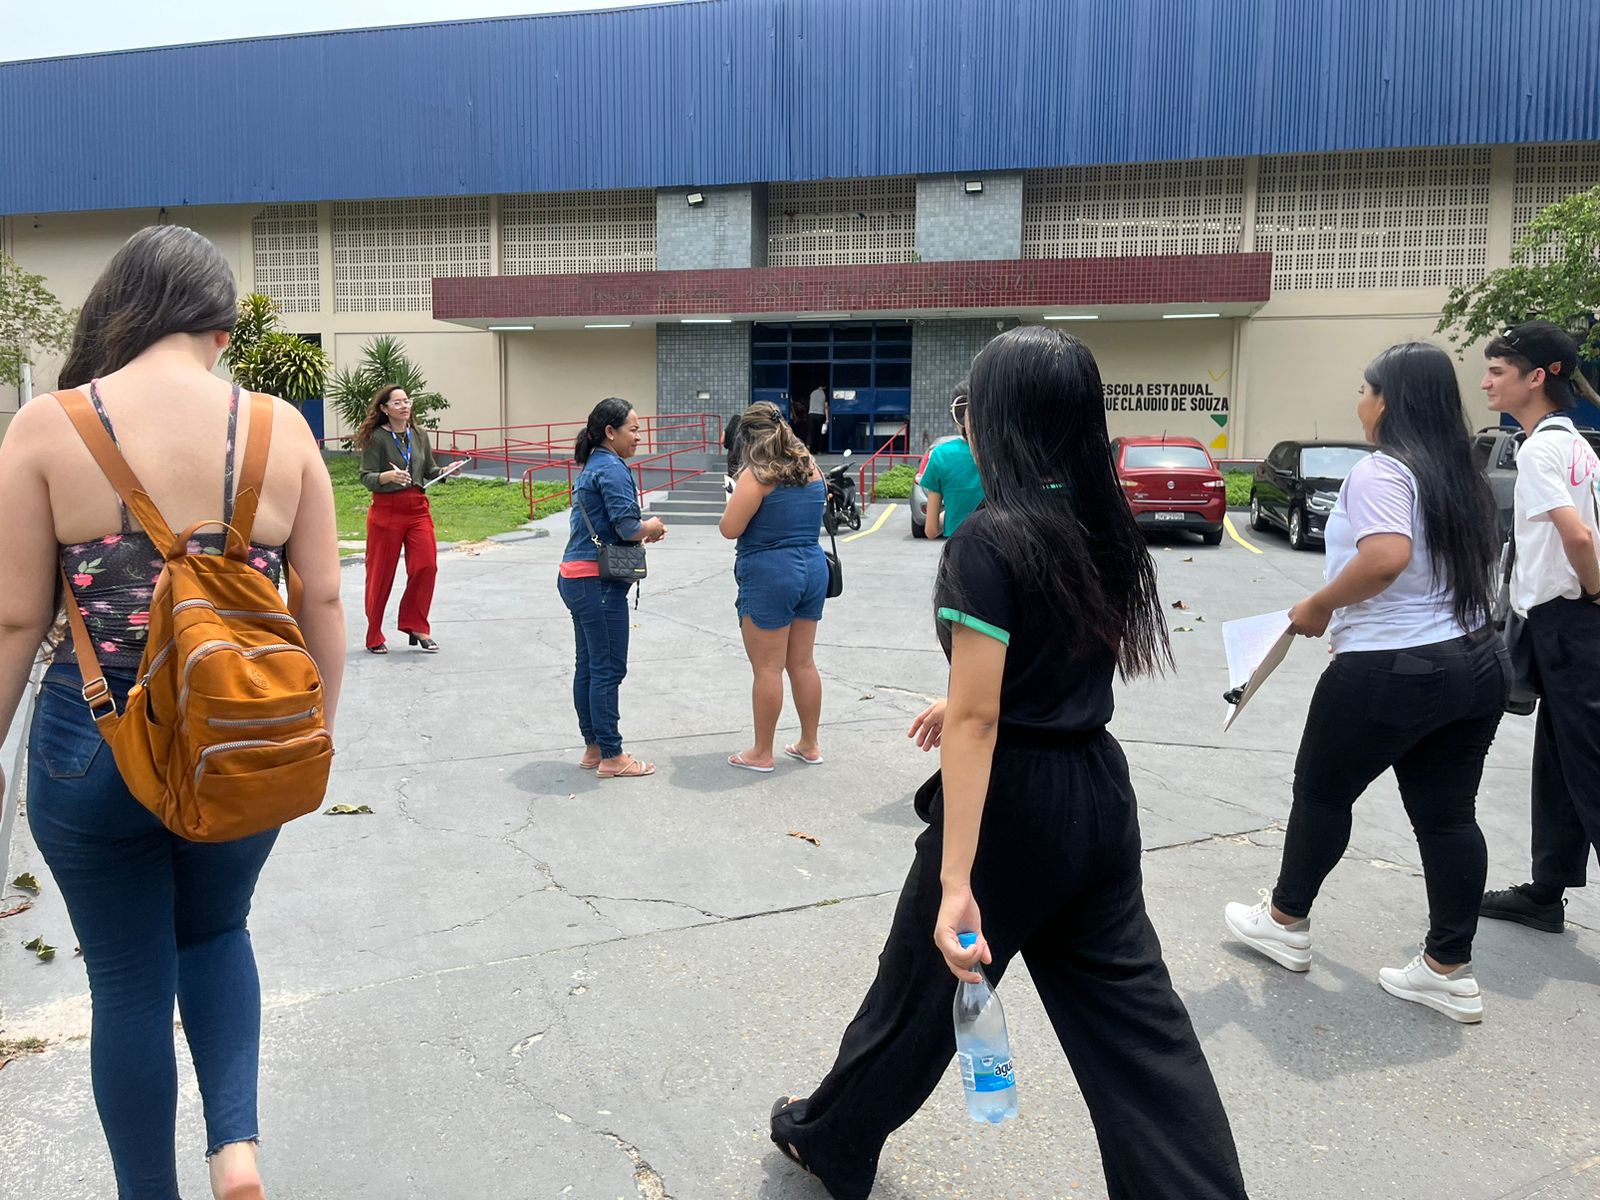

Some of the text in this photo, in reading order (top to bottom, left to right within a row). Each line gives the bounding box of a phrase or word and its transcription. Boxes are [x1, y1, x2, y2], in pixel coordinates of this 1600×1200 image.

[1101, 383, 1213, 396] ESCOLA ESTADUAL
[1171, 397, 1187, 411] DE
[1190, 397, 1229, 412] SOUZA
